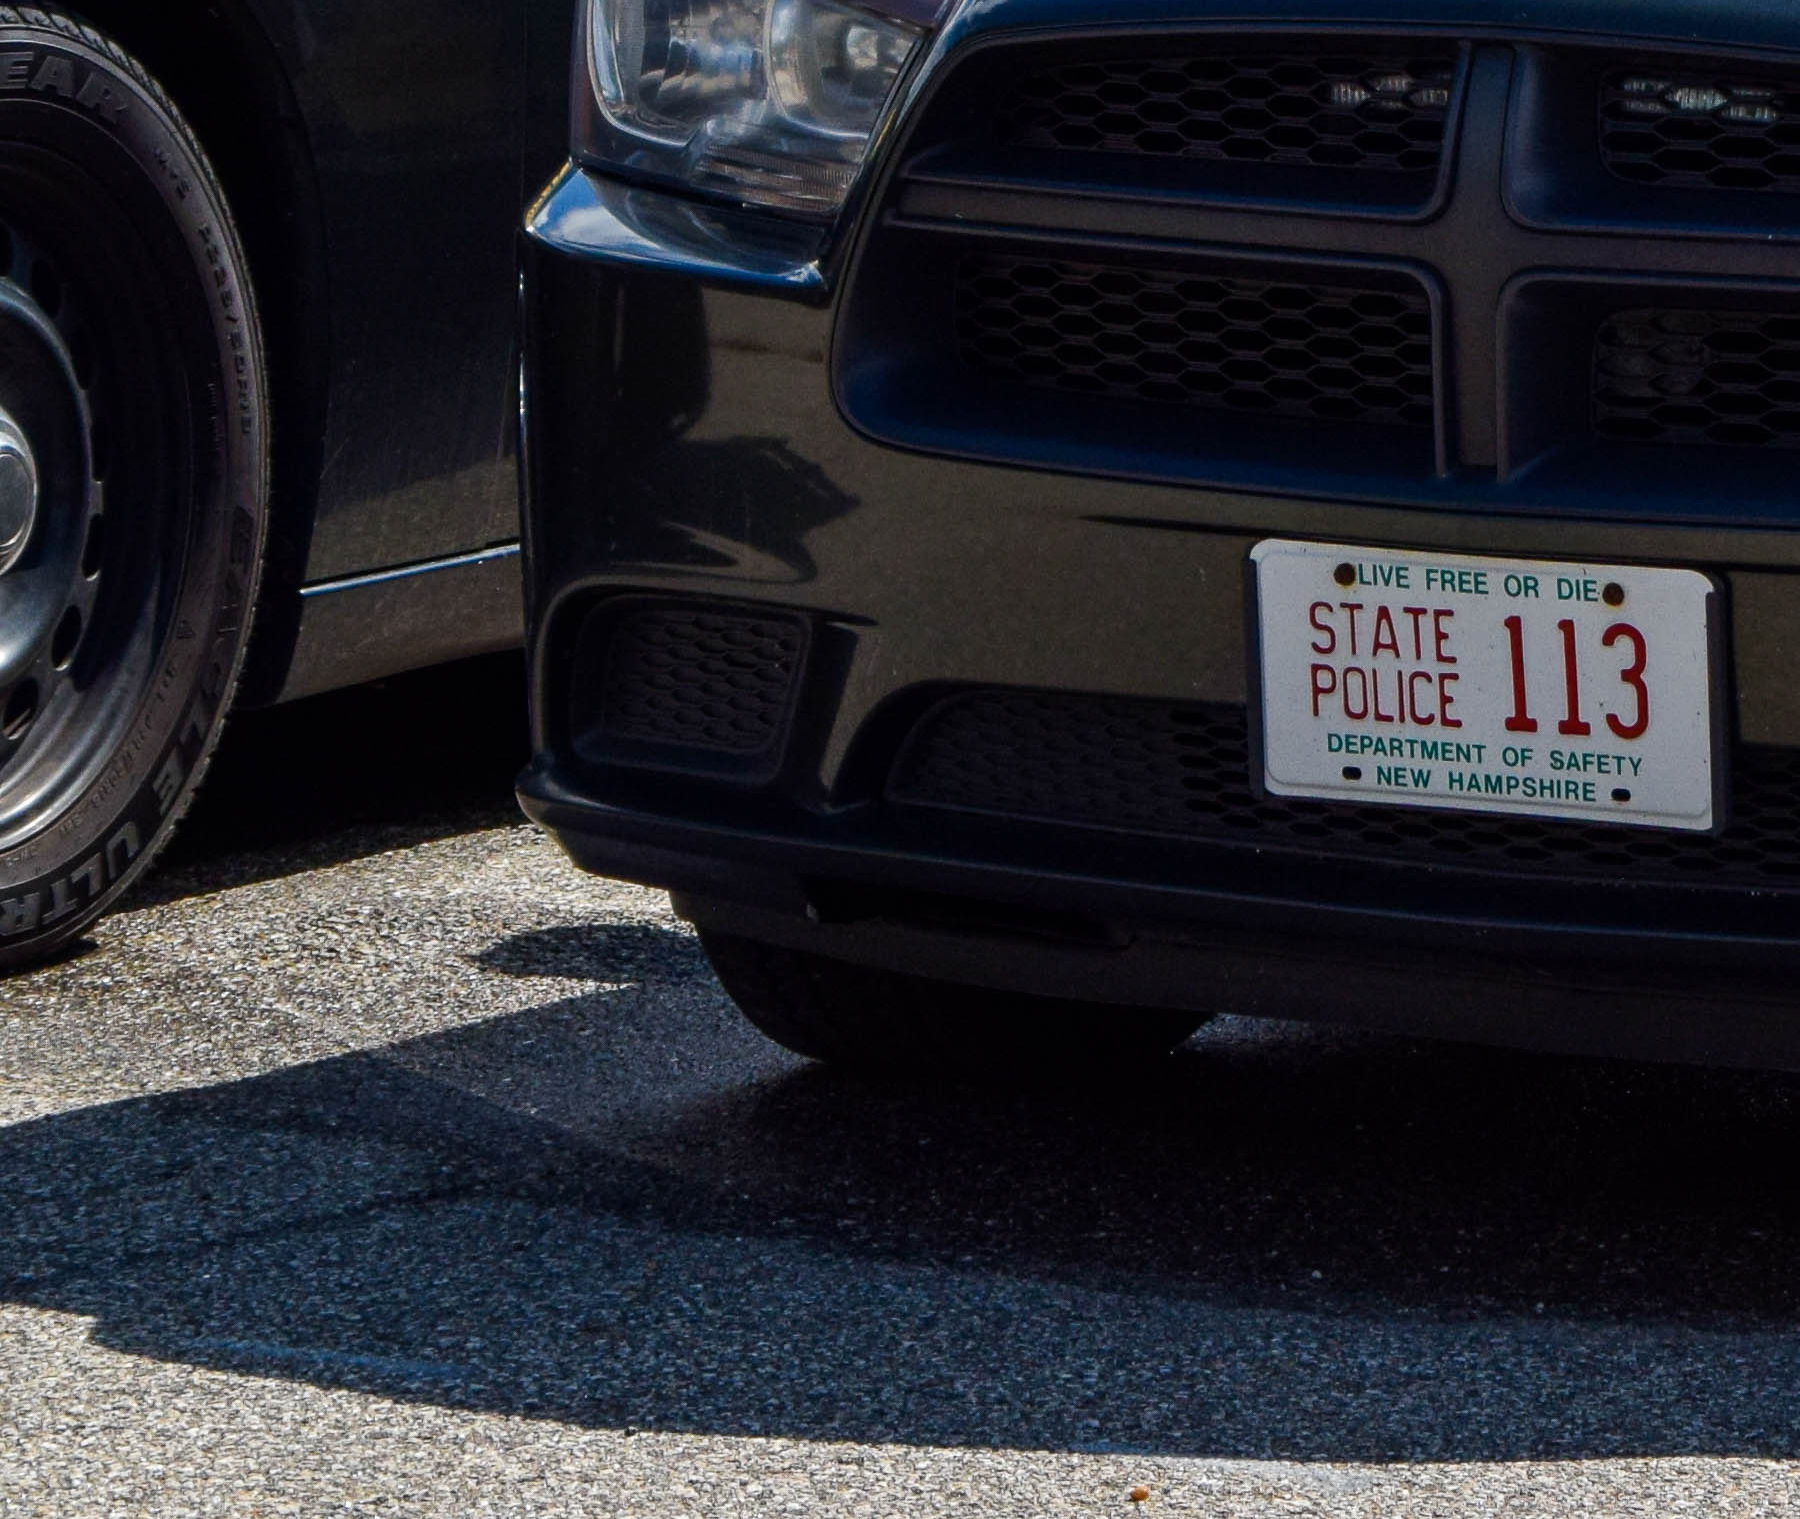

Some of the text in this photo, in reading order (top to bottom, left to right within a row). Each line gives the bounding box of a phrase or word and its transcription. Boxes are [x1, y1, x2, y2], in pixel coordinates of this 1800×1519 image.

[1357, 563, 1599, 602] LIVE FREE OR DIE
[1309, 601, 1459, 665] STATE
[1311, 663, 1463, 729] POLICE
[1504, 615, 1650, 740] 113
[1327, 732, 1643, 777] DEPARTMENT OF SAFETY
[1376, 764, 1598, 803] NEW HAMPSHIRE
